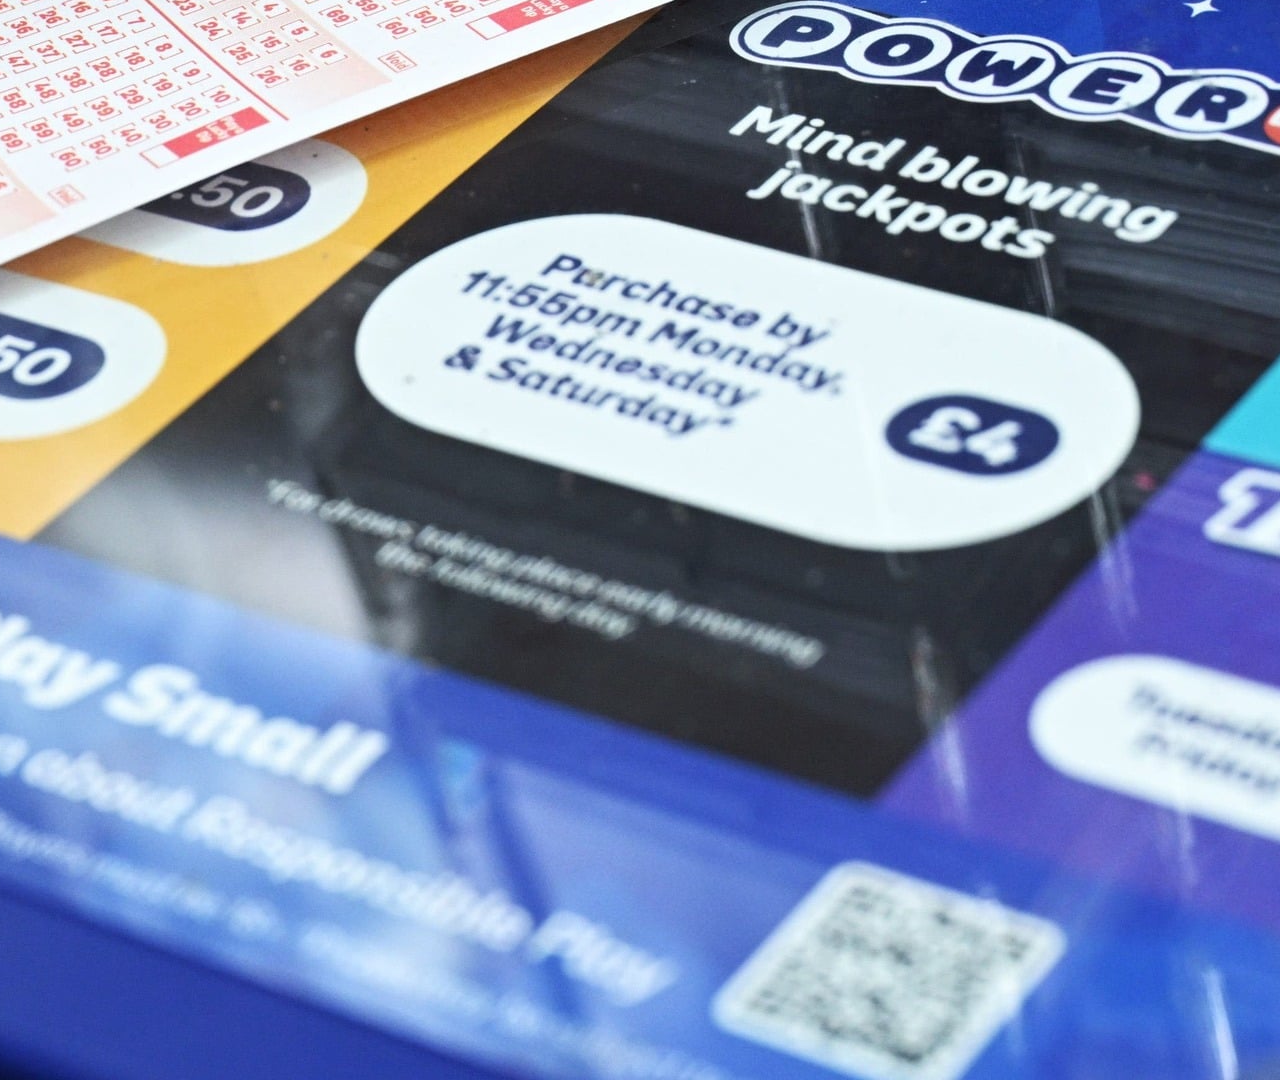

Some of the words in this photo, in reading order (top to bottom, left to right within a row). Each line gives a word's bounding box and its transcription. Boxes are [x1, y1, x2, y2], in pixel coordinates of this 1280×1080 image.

[383, 53, 411, 70] Void
[730, 106, 904, 170] Mind
[901, 147, 1175, 241] blowing
[749, 160, 1051, 257] jackpots
[463, 271, 641, 336] 11:55pm
[542, 254, 759, 327] Purchase
[766, 313, 827, 348] by
[444, 346, 480, 370] &
[486, 315, 753, 407] Wednesday
[910, 402, 1022, 467] £4
[104, 666, 381, 790] Small
[26, 750, 194, 828] about
